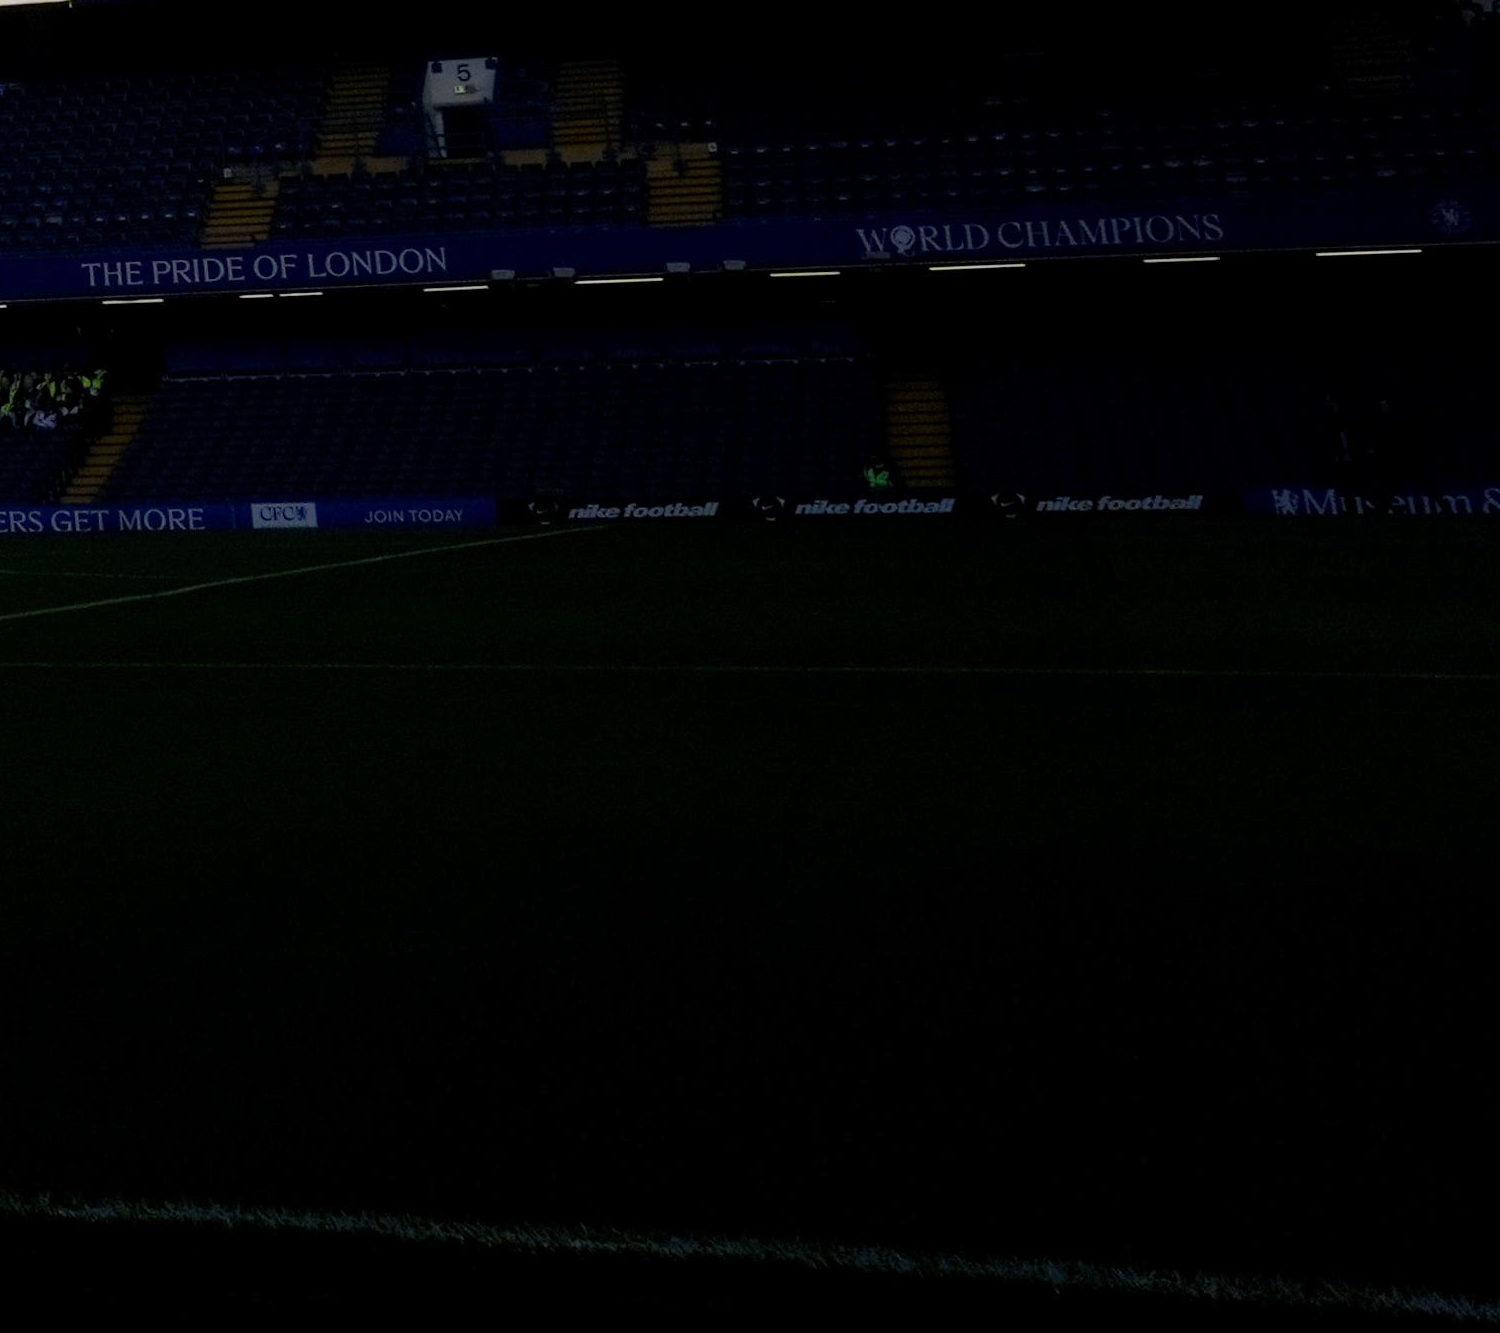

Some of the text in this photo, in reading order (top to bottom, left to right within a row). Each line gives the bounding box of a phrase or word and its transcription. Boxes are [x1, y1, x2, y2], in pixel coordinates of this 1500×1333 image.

[457, 64, 470, 82] 5
[855, 213, 1225, 257] WORLD CHAMPIONS
[80, 246, 447, 287] THE PRIDE OF LONDON
[569, 501, 719, 519] nike football
[794, 498, 956, 515] nike football
[1036, 494, 1203, 512] nike football
[50, 508, 111, 533] GET
[118, 507, 205, 532] MORE
[364, 507, 464, 524] JOIN TODAY
